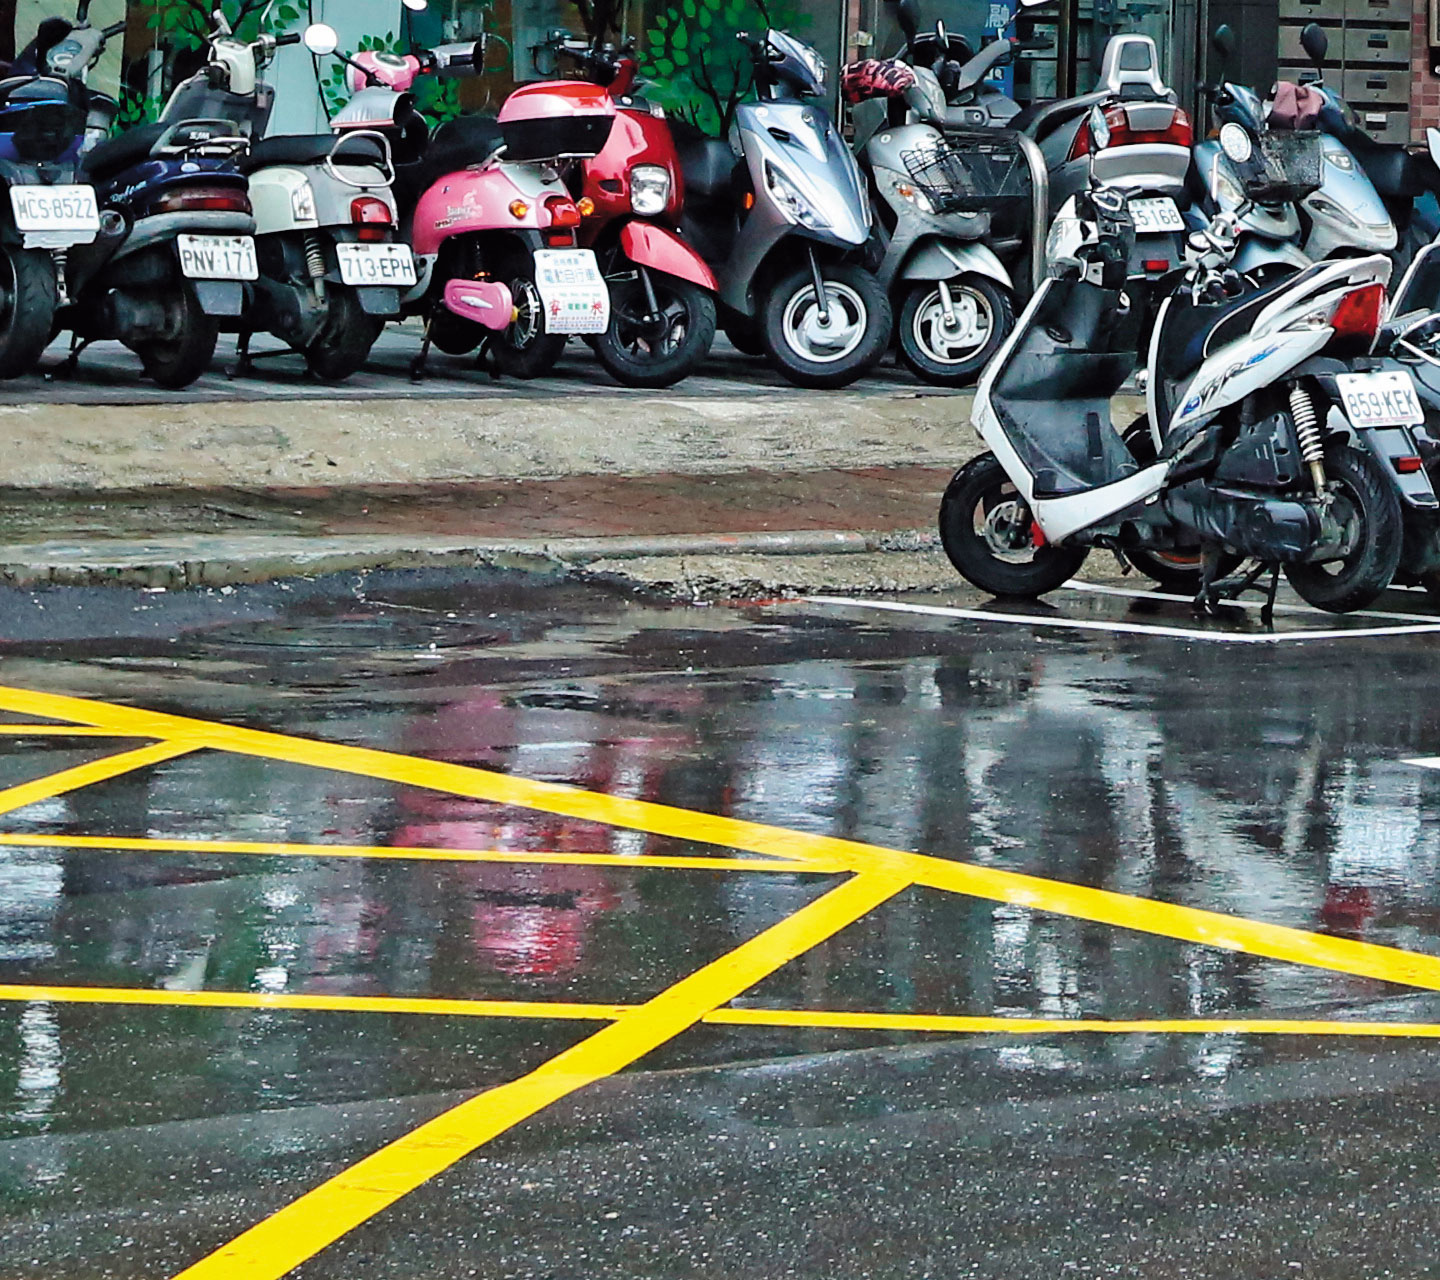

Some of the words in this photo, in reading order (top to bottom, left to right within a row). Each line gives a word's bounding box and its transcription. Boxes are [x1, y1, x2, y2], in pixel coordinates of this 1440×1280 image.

[16, 198, 95, 219] MCS-8522
[182, 249, 254, 273] PNV-171
[342, 257, 414, 278] 713-EPH
[1347, 389, 1420, 418] 859-KEK
